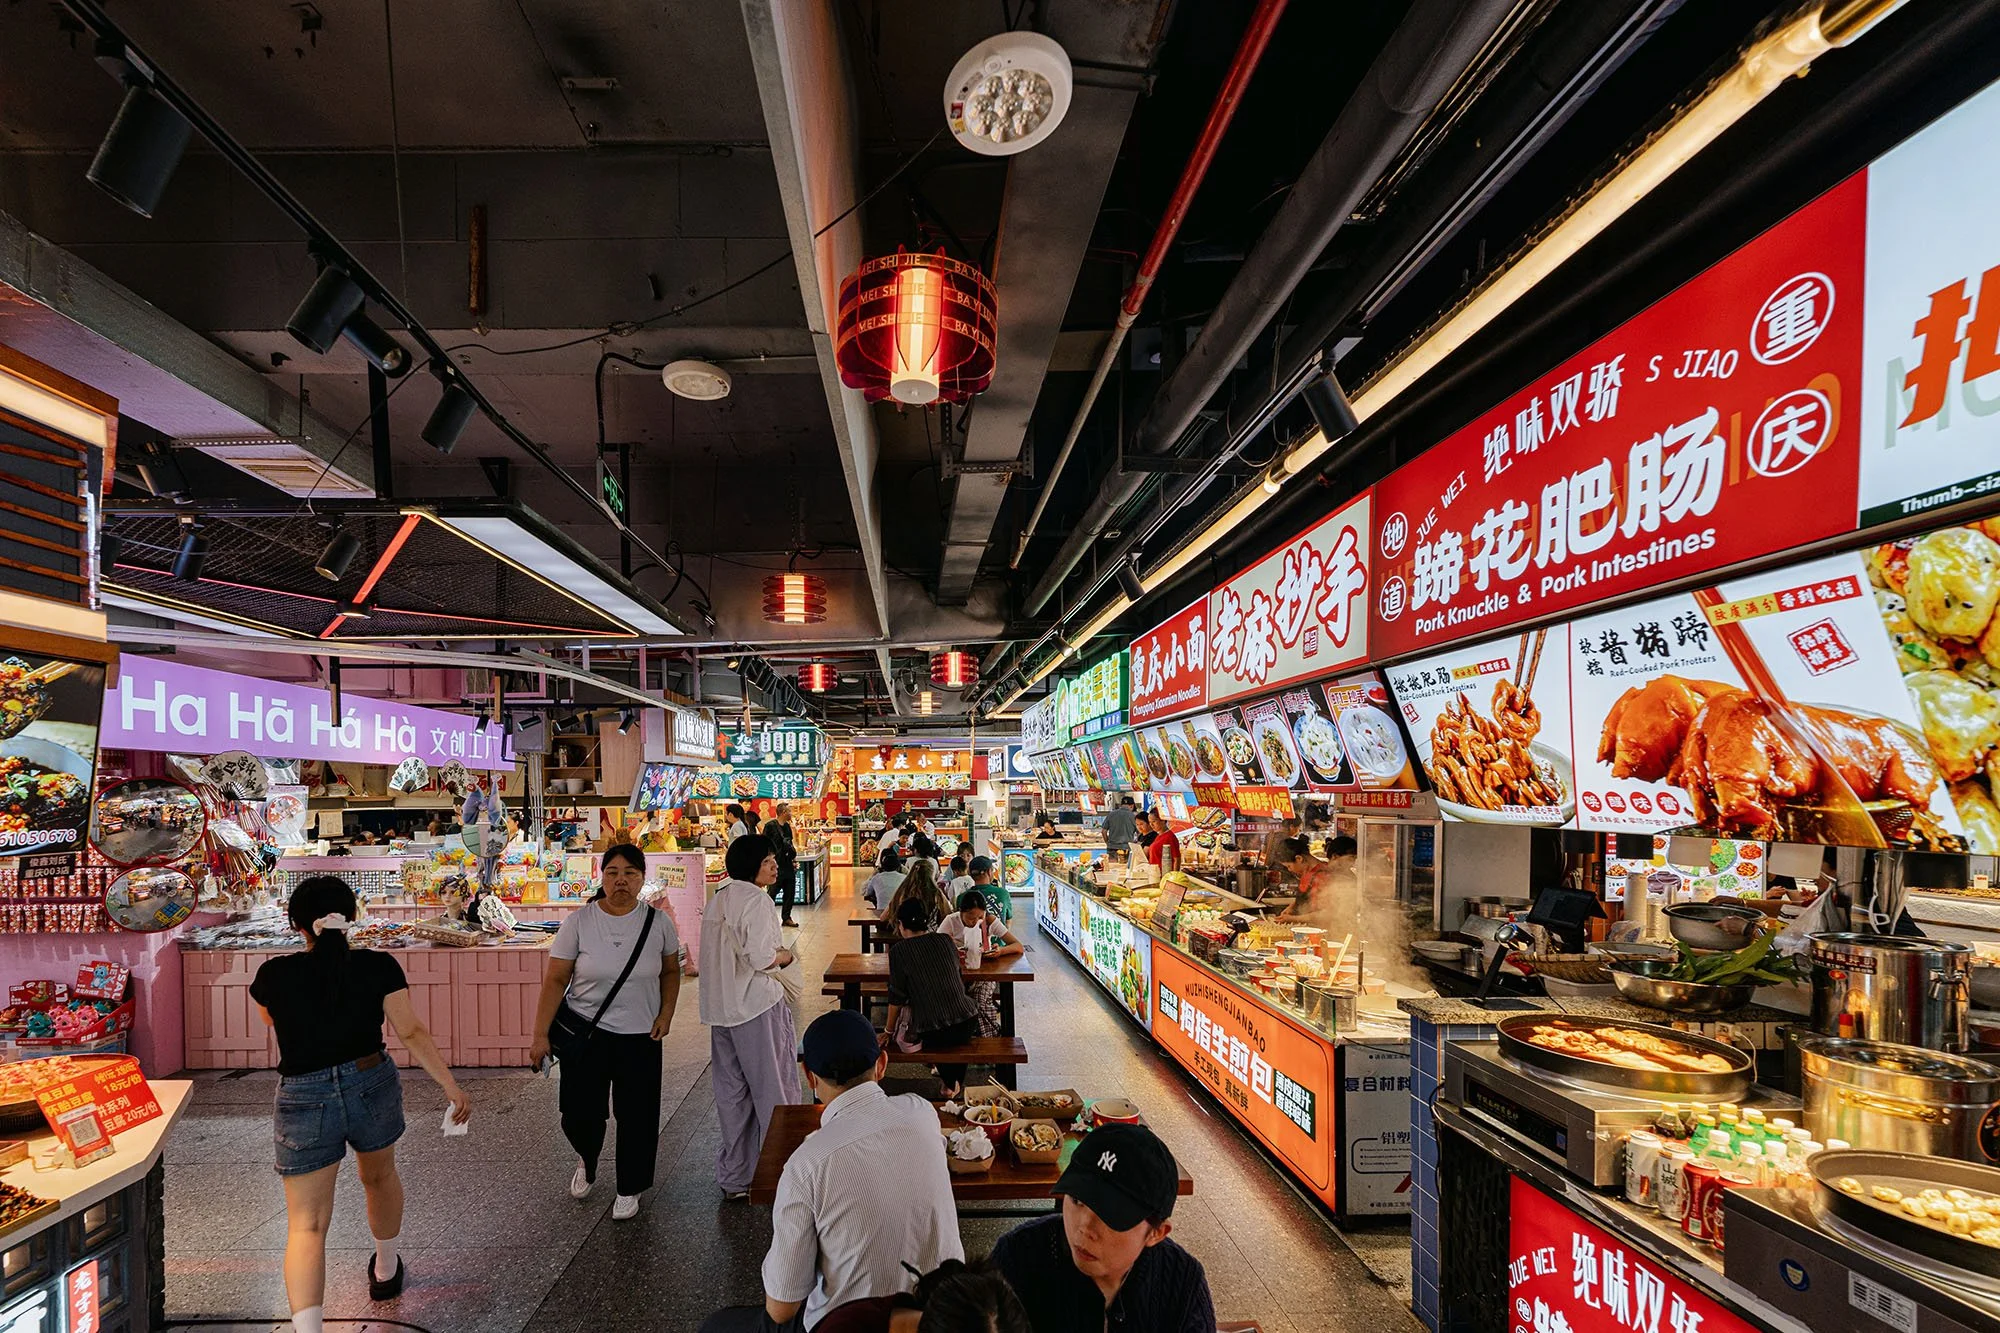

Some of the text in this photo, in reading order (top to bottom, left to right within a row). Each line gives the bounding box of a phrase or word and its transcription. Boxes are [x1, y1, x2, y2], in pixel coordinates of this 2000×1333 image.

[954, 261, 968, 274] BA
[957, 291, 971, 305] BA
[955, 320, 968, 333] BA
[1646, 348, 1739, 383] S JIAO
[1483, 354, 1625, 482] 绝味双骄
[1411, 405, 1726, 611] 蹄花肥肠
[1415, 470, 1467, 545] JUE WEI
[1416, 526, 1717, 636] Pork Knuckle & Pork Intestines
[1212, 526, 1367, 683] 老麻抄手
[1131, 615, 1206, 701] 重庆小面
[1609, 654, 1717, 678] Red-Cooked Pork Trotters
[1177, 684, 1201, 703] Noodles
[1399, 682, 1477, 702] Red-Cooked Pork Intestines
[121, 675, 207, 736] Ha
[230, 691, 294, 743] Hā
[374, 714, 416, 753] Hà
[430, 727, 499, 759] 文创工厂
[1237, 791, 1291, 812] 老麻抄手10元
[24, 867, 70, 879] 重庆003店
[1185, 983, 1266, 1053] MUZHISHENGJIANBAO
[1179, 998, 1272, 1105] 拇指生煎包
[103, 1073, 142, 1094] 18元/份
[124, 1101, 159, 1122] 20元/份
[1097, 1150, 1117, 1172] NY
[1509, 1247, 1557, 1288] JUE WEI
